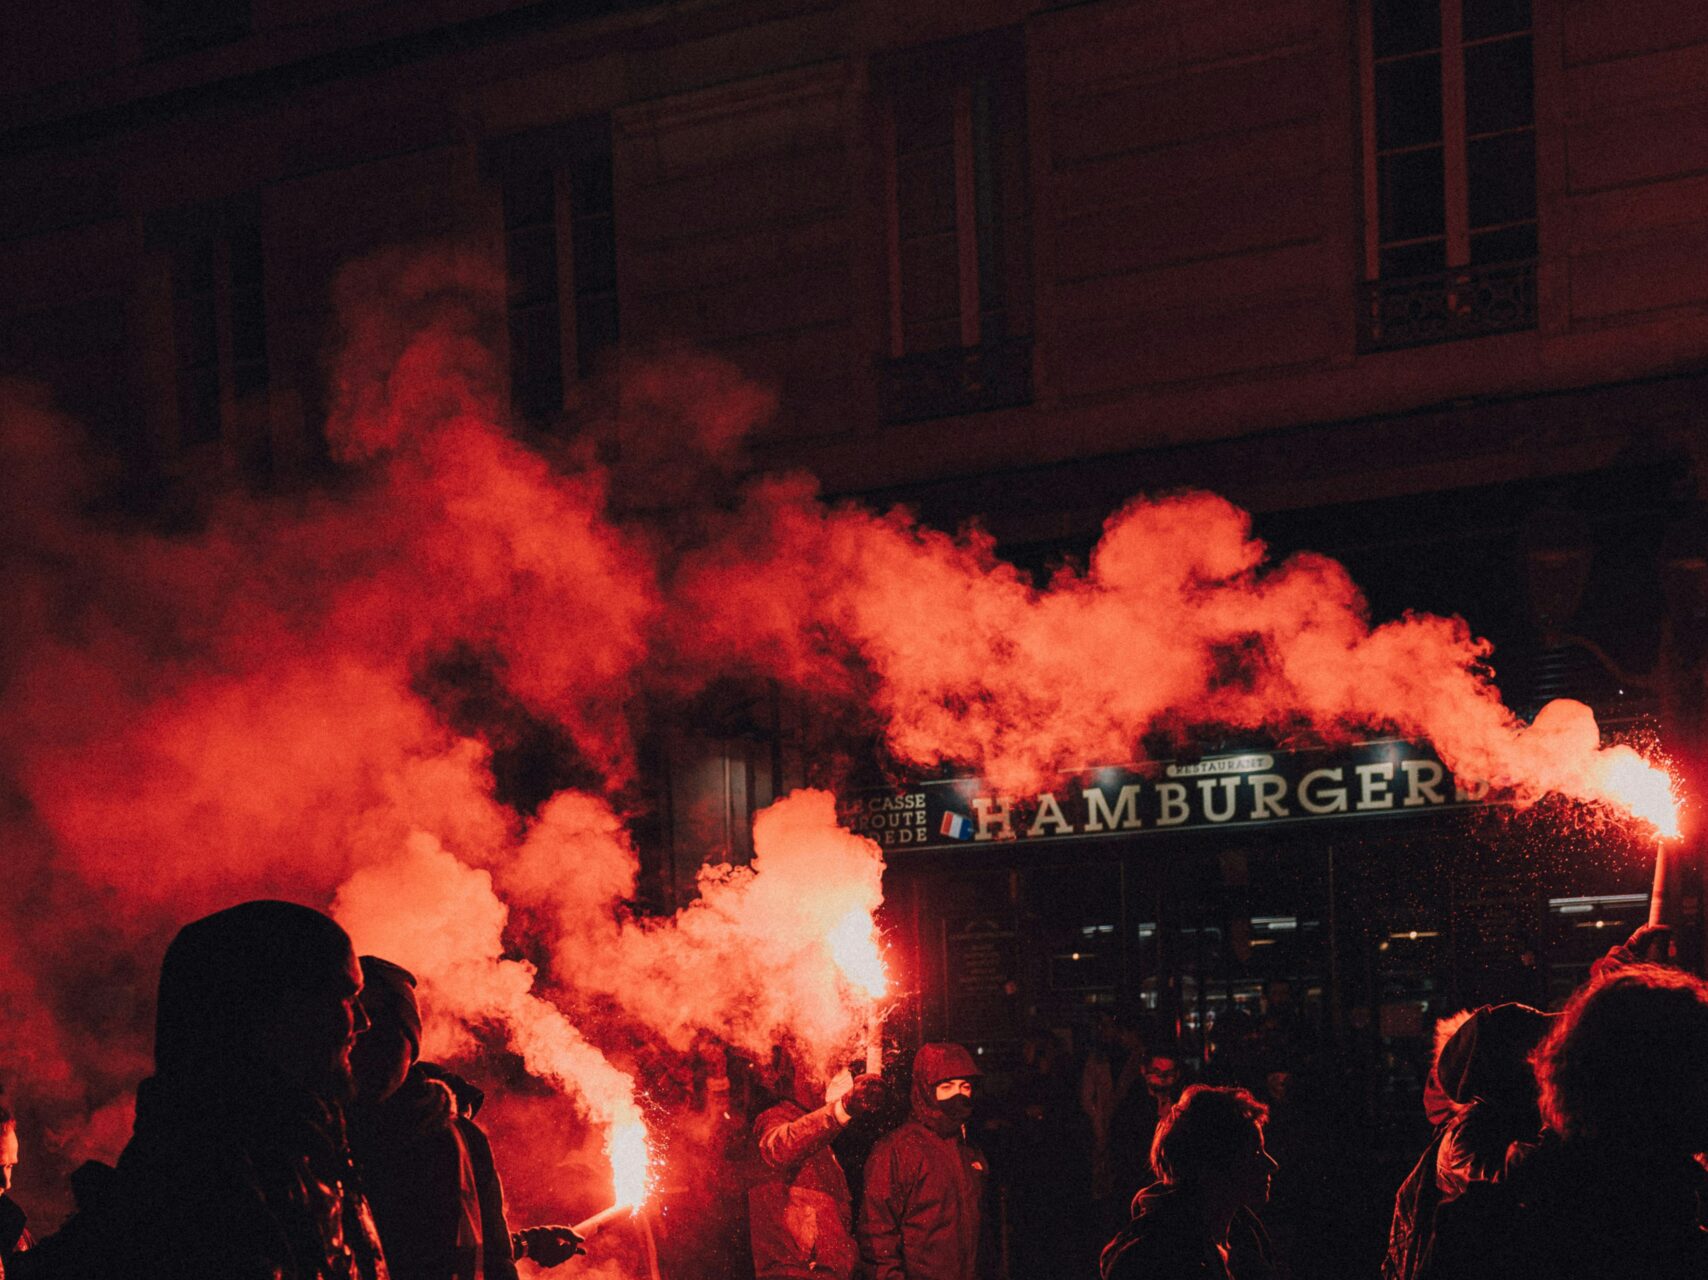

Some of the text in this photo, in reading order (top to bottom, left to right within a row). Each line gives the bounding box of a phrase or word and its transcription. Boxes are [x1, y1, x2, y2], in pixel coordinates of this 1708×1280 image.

[1176, 757, 1266, 775] RESTAURANT
[868, 793, 926, 812] CASSE
[846, 810, 927, 831] ROUTE
